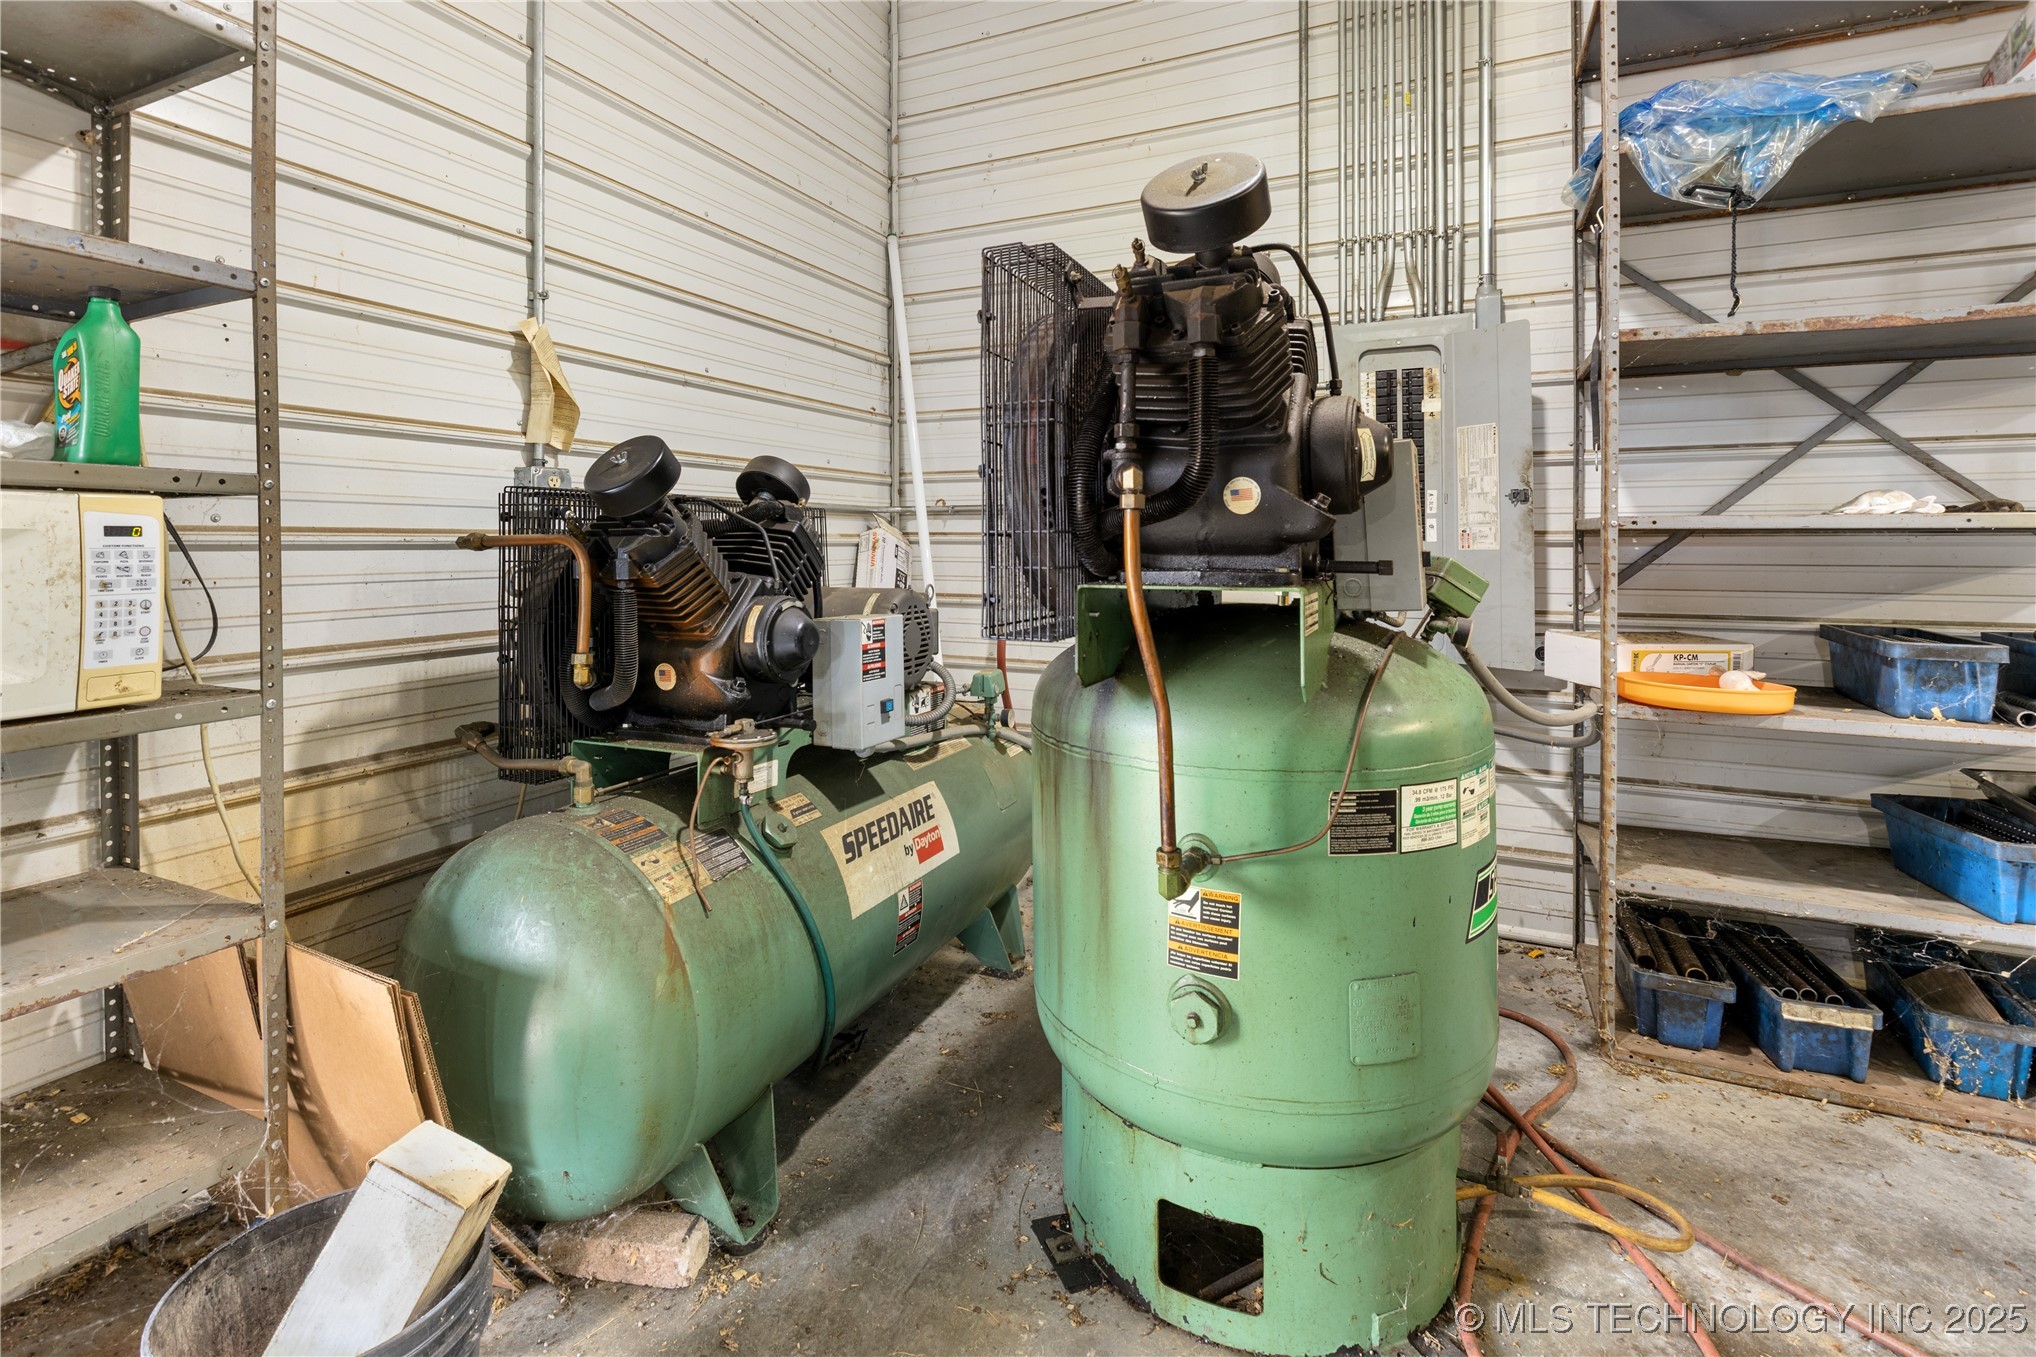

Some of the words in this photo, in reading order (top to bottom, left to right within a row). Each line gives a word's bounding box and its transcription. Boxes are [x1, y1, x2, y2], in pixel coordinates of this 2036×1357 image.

[58, 361, 80, 392] QUAKER
[63, 379, 80, 399] STATE
[1673, 653, 1699, 661] KP-CM
[841, 794, 935, 865] SPEEDAIRE
[903, 844, 914, 857] by
[914, 829, 941, 850] Dayton
[1208, 892, 1239, 902] WARNING
[1181, 920, 1233, 935] AVERTISSEMENT
[1184, 946, 1228, 960] ADVERTENCIA
